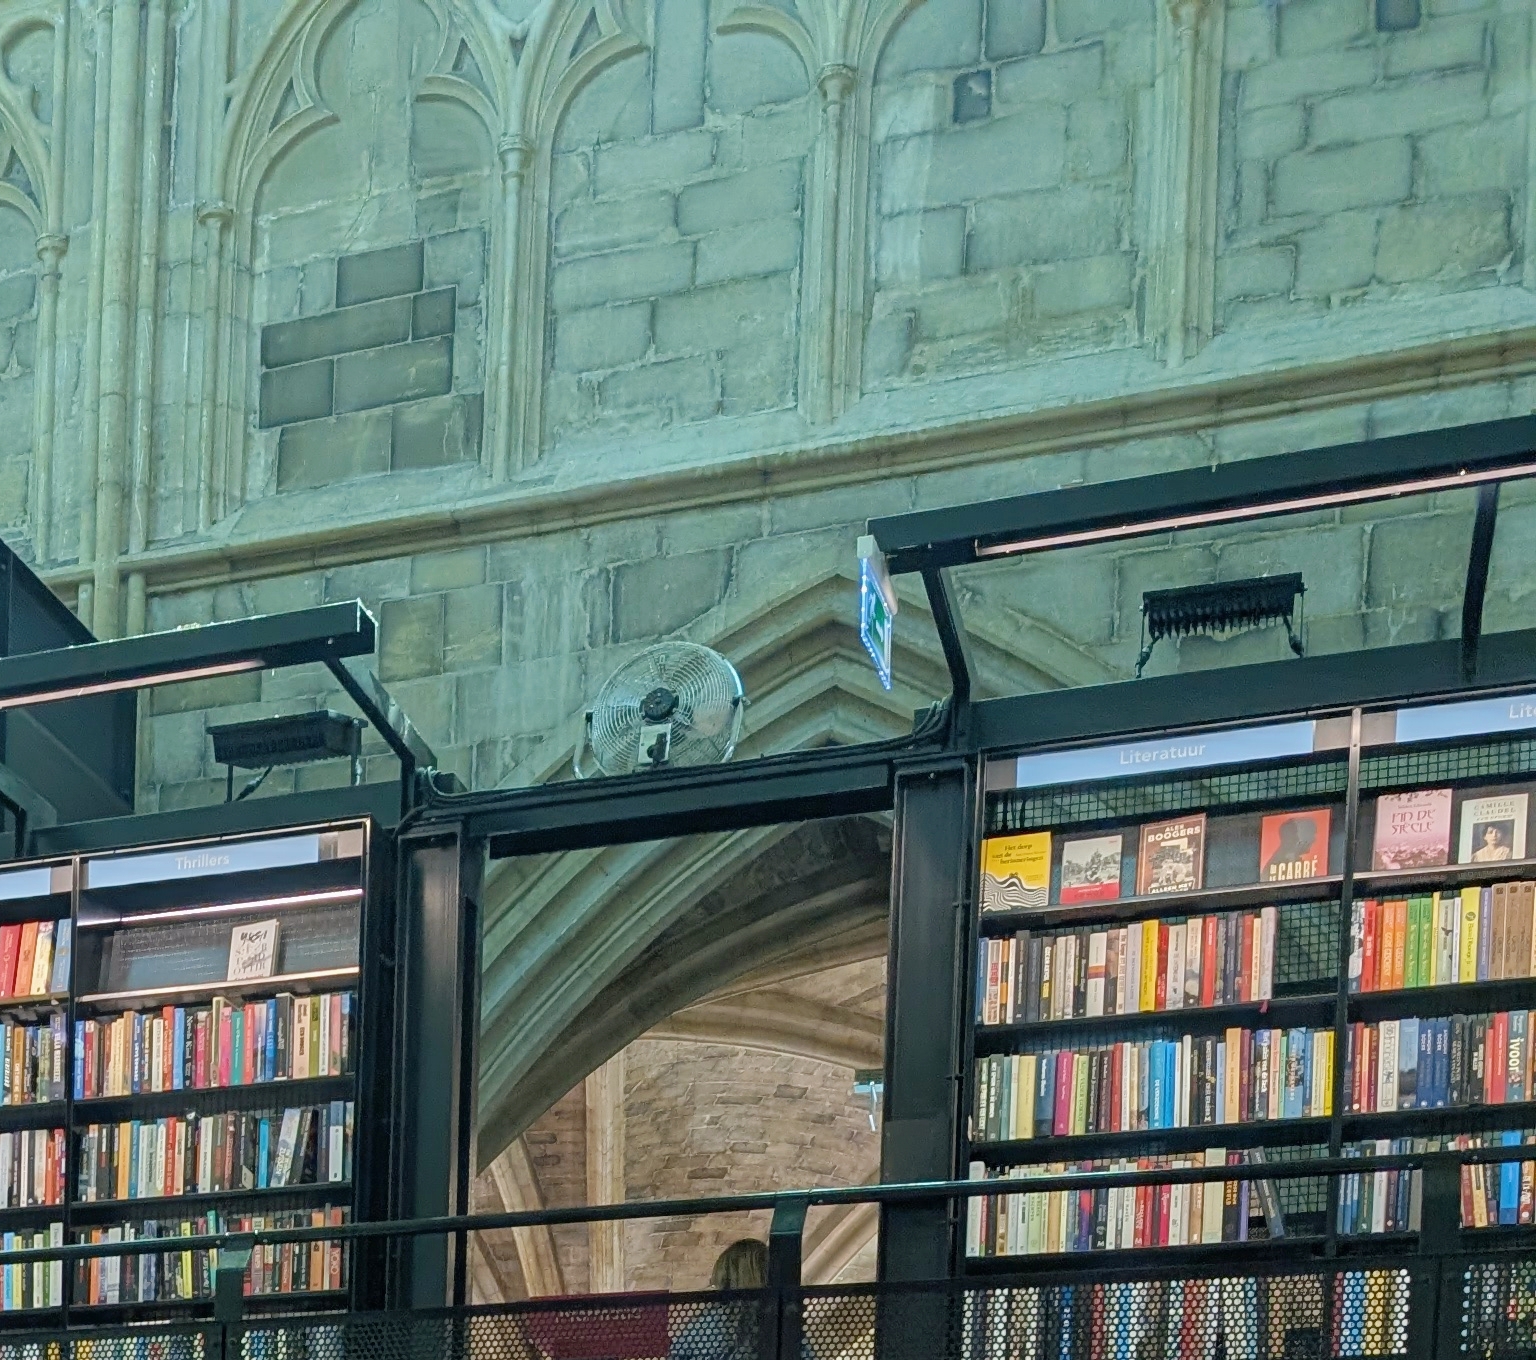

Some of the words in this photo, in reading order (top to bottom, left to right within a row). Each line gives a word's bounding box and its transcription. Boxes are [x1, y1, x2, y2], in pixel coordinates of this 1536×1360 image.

[1120, 745, 1206, 765] Literatuur
[1473, 808, 1516, 817] CLAUDEL
[1474, 801, 1514, 810] CAMILLE
[1148, 826, 1200, 842] BOOGERS
[175, 852, 229, 871] Thrillers
[1509, 1037, 1522, 1075] ivoor
